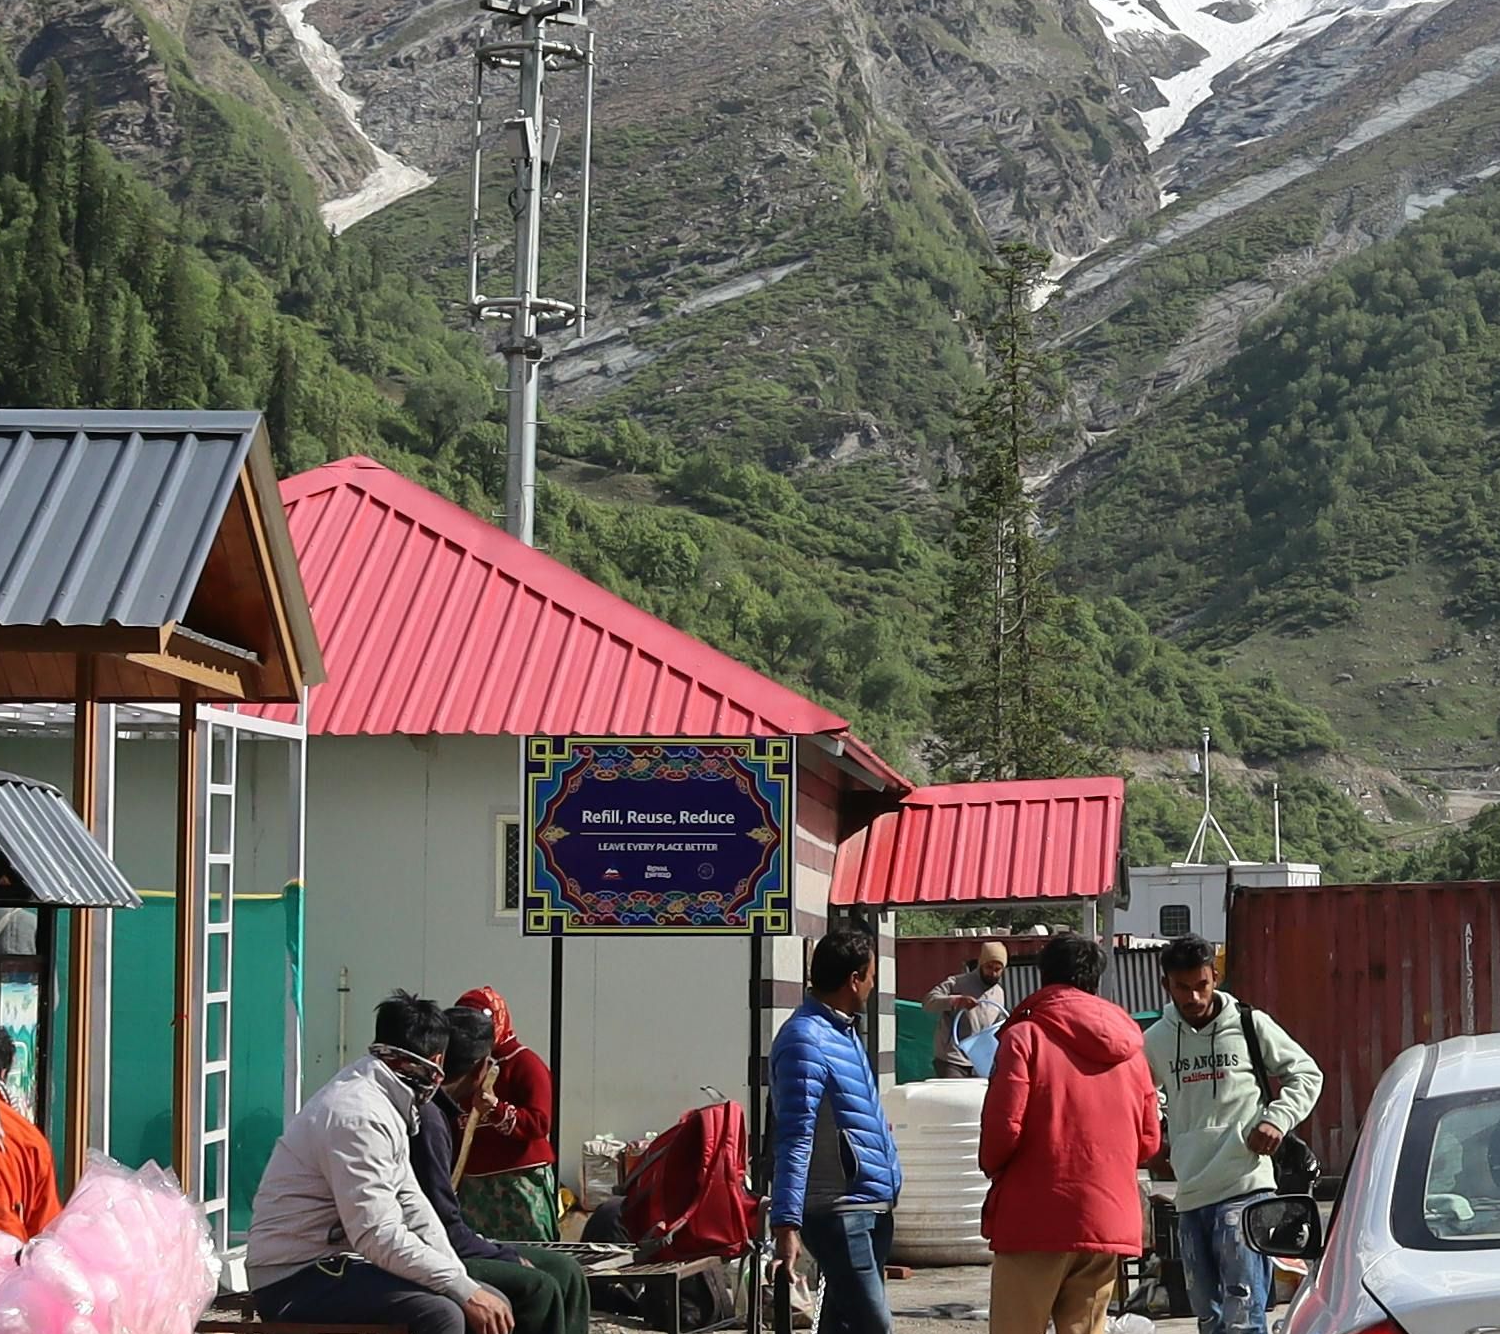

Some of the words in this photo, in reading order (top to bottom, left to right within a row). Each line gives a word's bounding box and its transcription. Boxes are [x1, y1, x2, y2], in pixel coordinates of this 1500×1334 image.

[581, 809, 625, 825] Refill,
[627, 810, 677, 825] Reuse,
[679, 810, 736, 824] Reduce
[598, 843, 626, 851] LEAVE
[627, 843, 655, 851] EVERY
[656, 843, 684, 851] PLACE
[685, 843, 719, 852] BETTER
[1169, 1058, 1191, 1074] LOS
